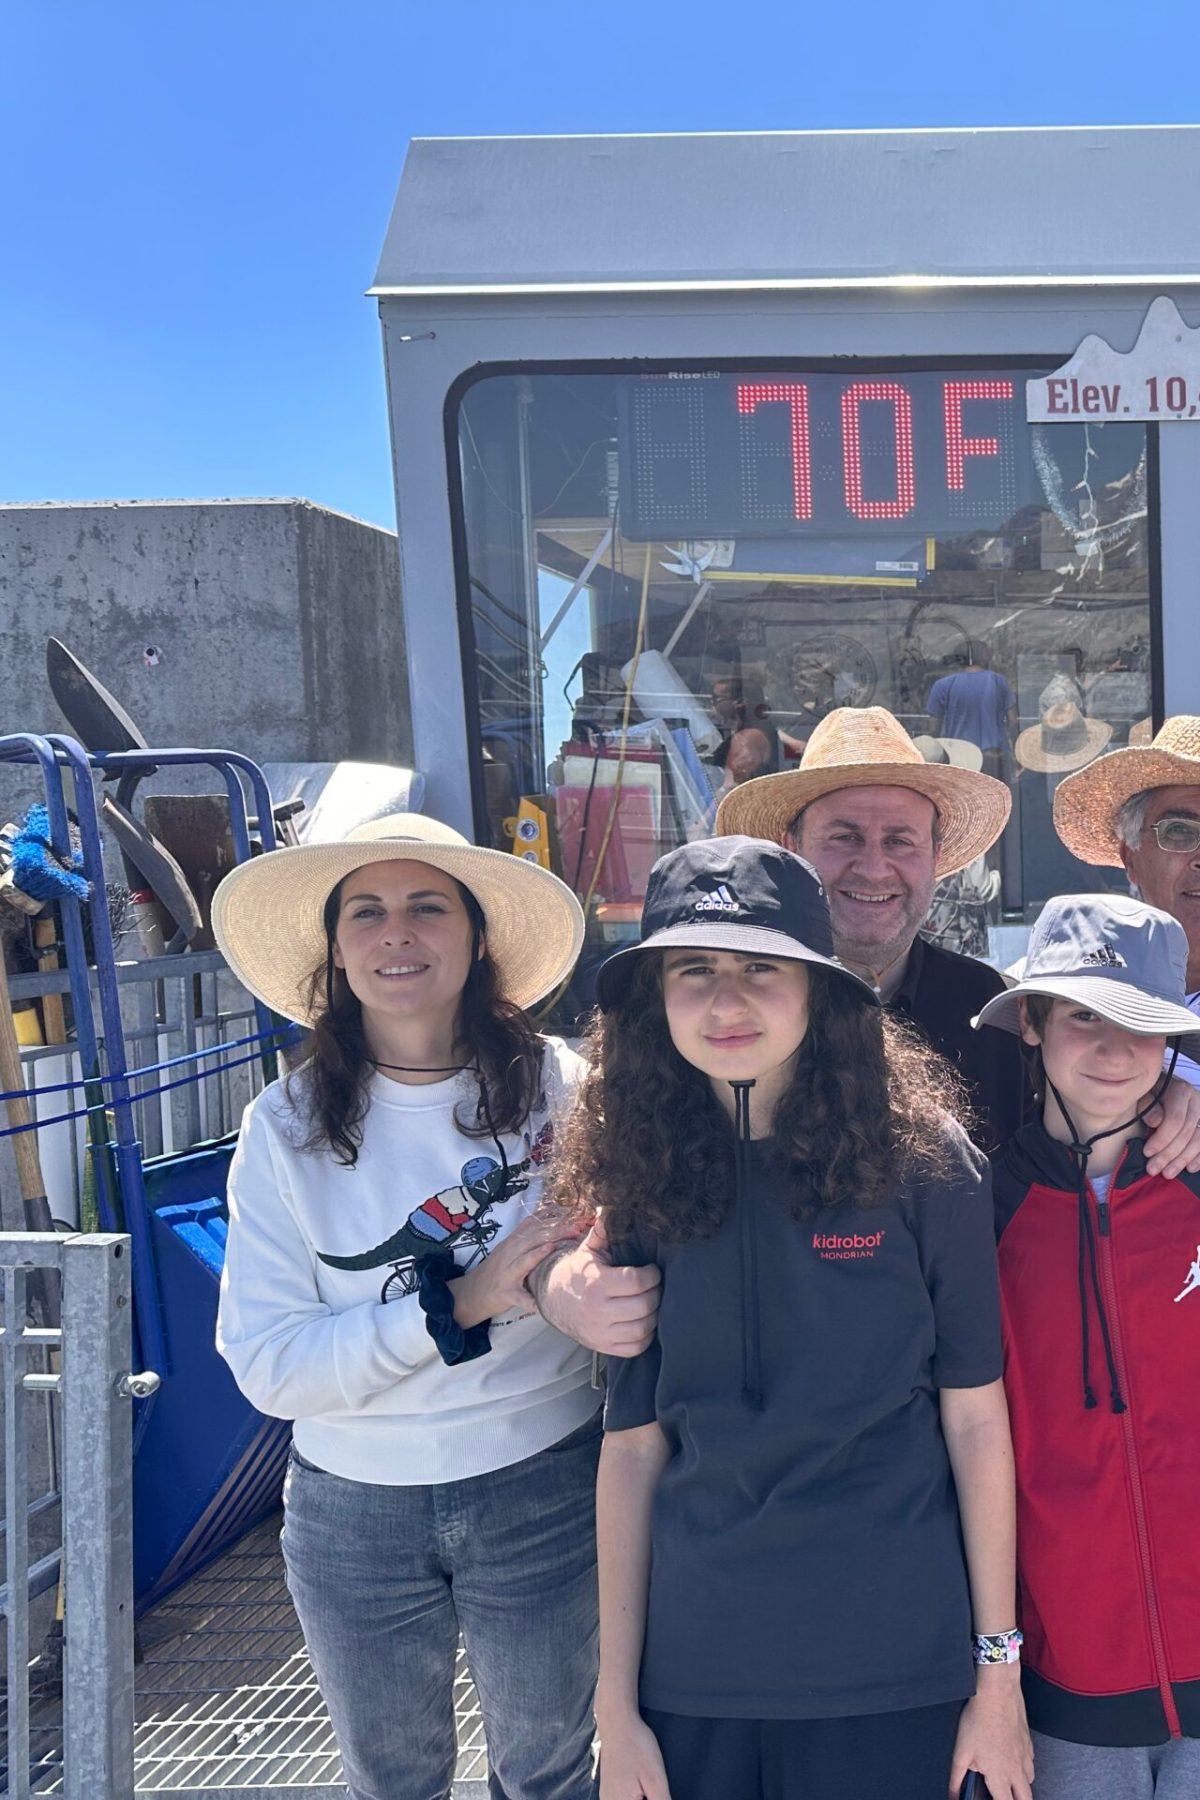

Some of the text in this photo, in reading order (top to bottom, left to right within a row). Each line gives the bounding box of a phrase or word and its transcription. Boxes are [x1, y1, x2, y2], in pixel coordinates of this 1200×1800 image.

[1046, 378, 1130, 414] Elev.
[737, 380, 1013, 520] 70 F
[695, 900, 740, 911] adidas
[820, 1250, 874, 1260] MONDRIAN
